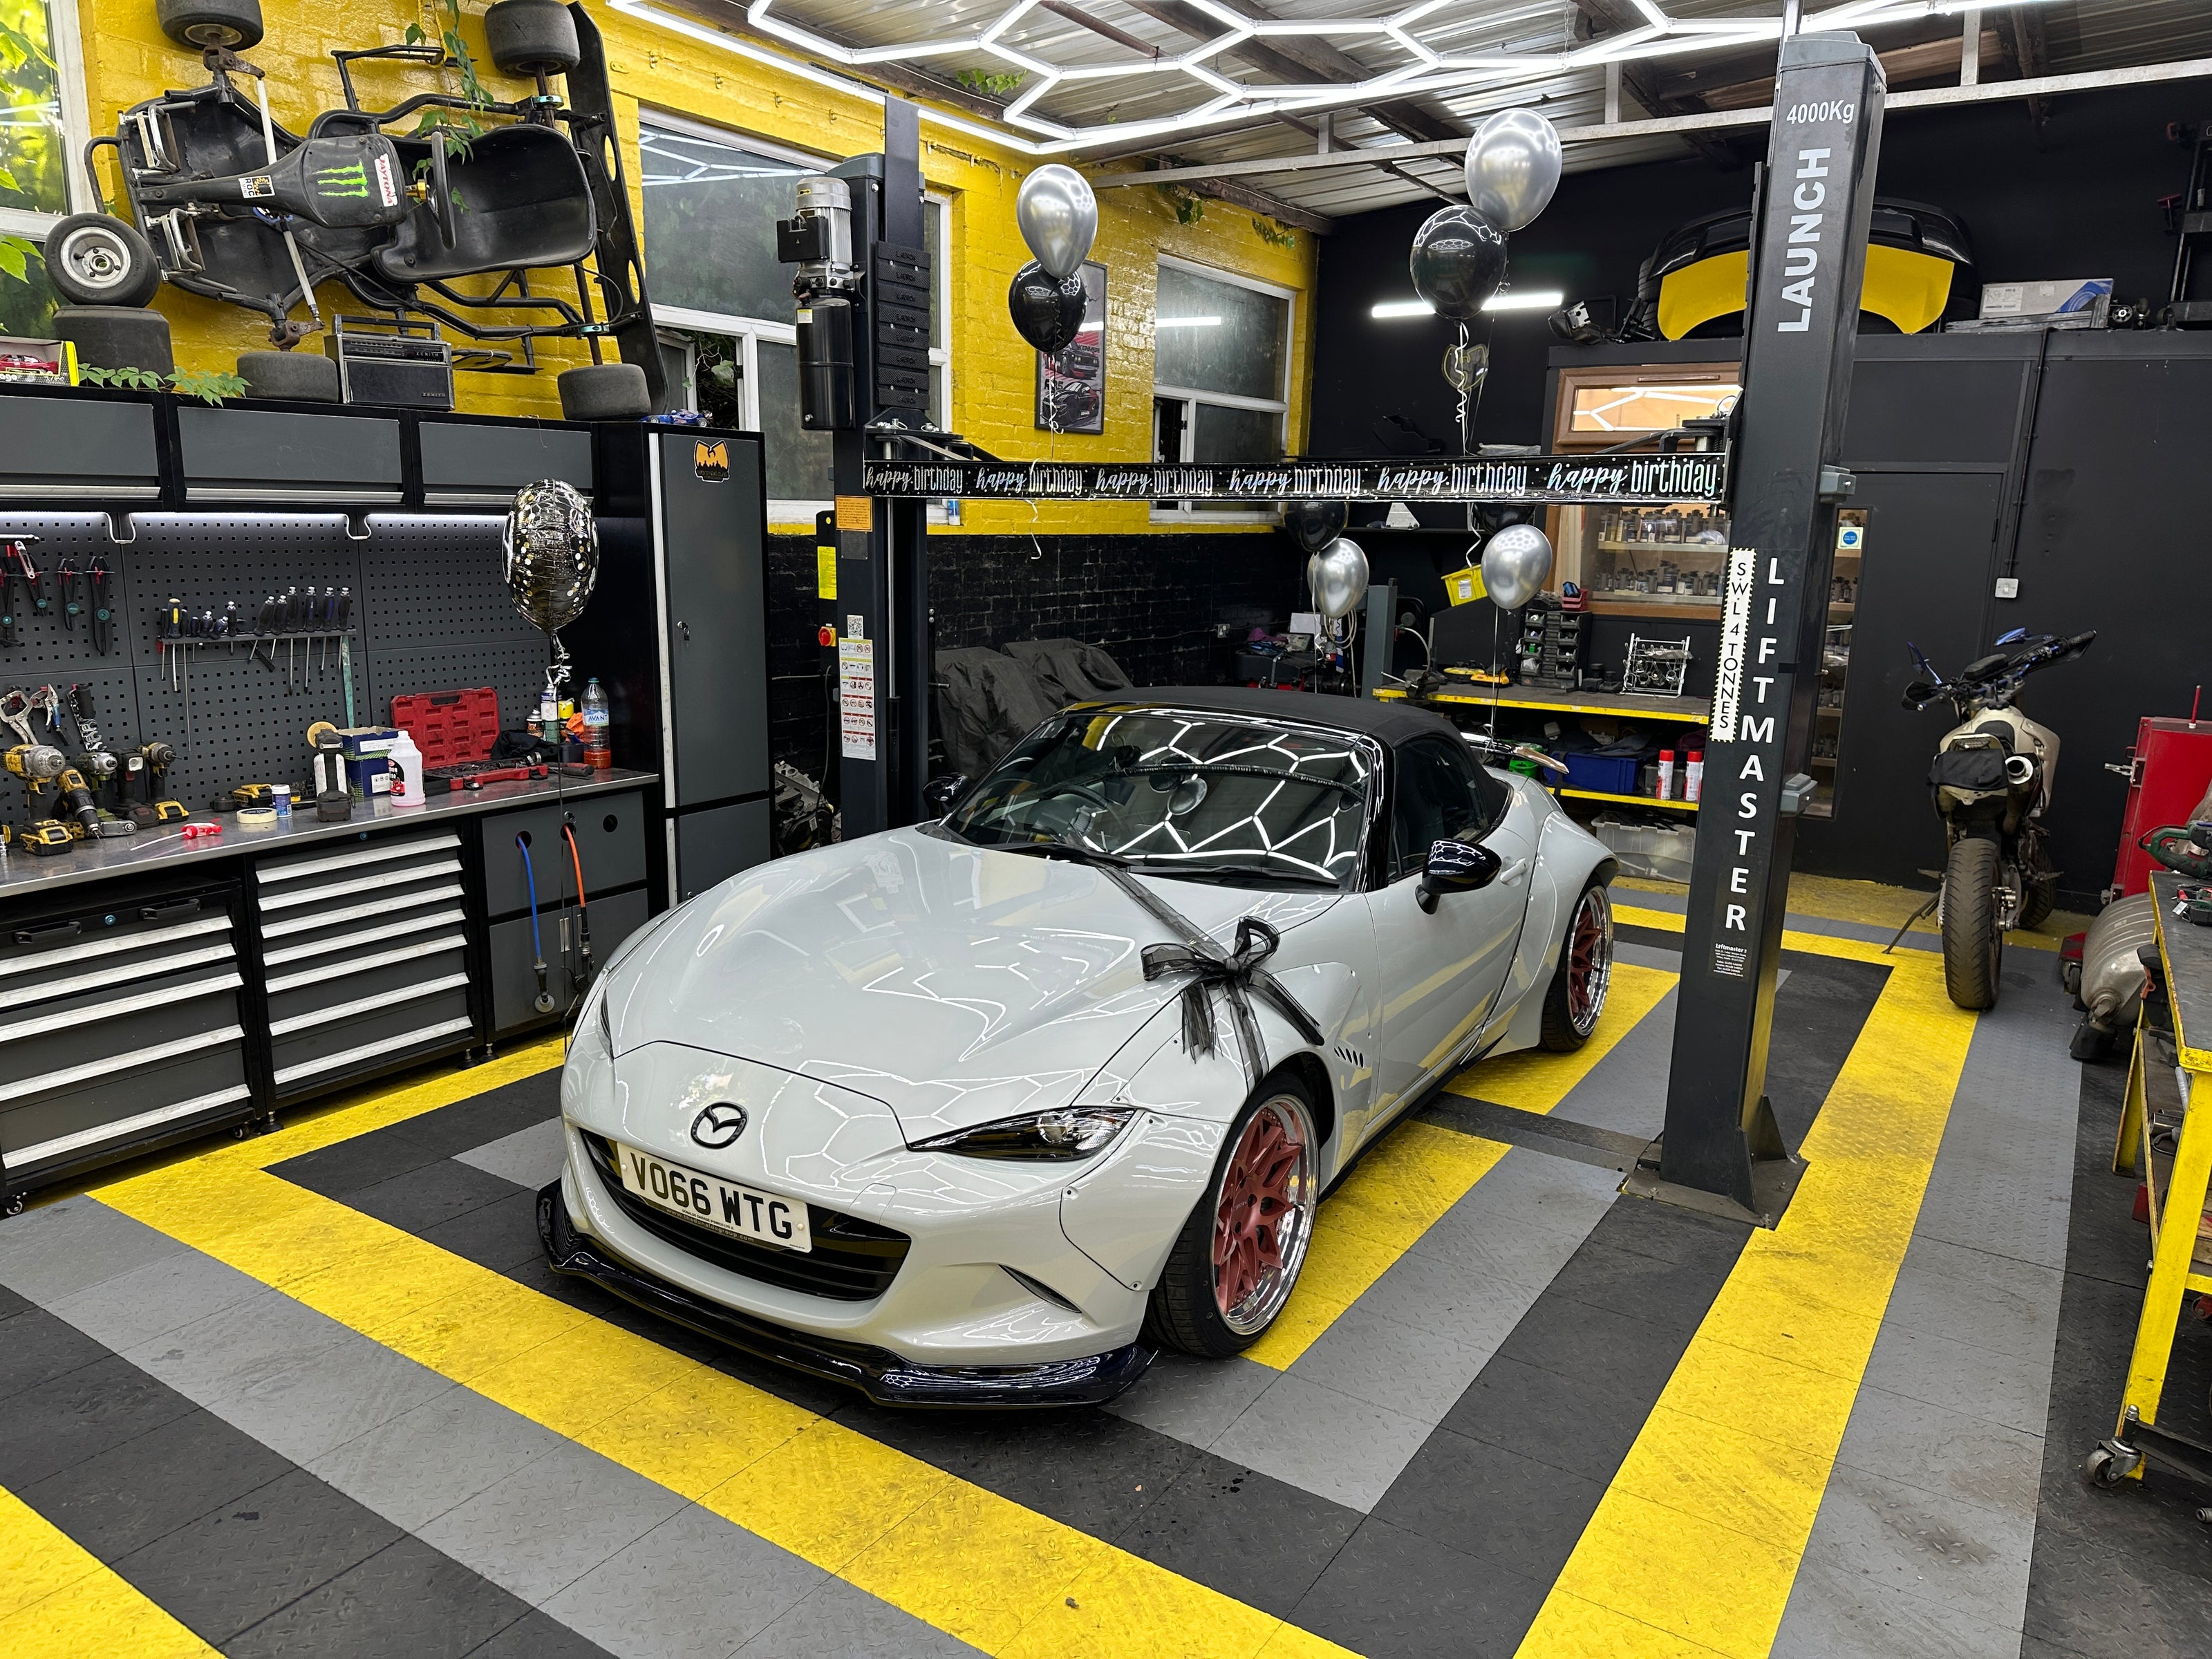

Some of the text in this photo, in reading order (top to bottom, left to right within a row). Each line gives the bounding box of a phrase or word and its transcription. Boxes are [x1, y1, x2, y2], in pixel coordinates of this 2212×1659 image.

[1786, 100, 1855, 124] 4000Kg
[245, 178, 255, 197] ROC
[1777, 147, 1831, 332] LAUNCH
[865, 460, 1718, 497] happy birthday happy birthday happy birthday happy birthday happy birthday happy birthday
[1730, 624, 1740, 636] 4
[1719, 643, 1738, 729] TONNES
[1725, 557, 1785, 931] LIFTMASTER
[1715, 943, 1744, 953] Liftmaster
[666, 1208, 755, 1243] www.thedonaldsgroup.com
[720, 1186, 793, 1239] WTG
